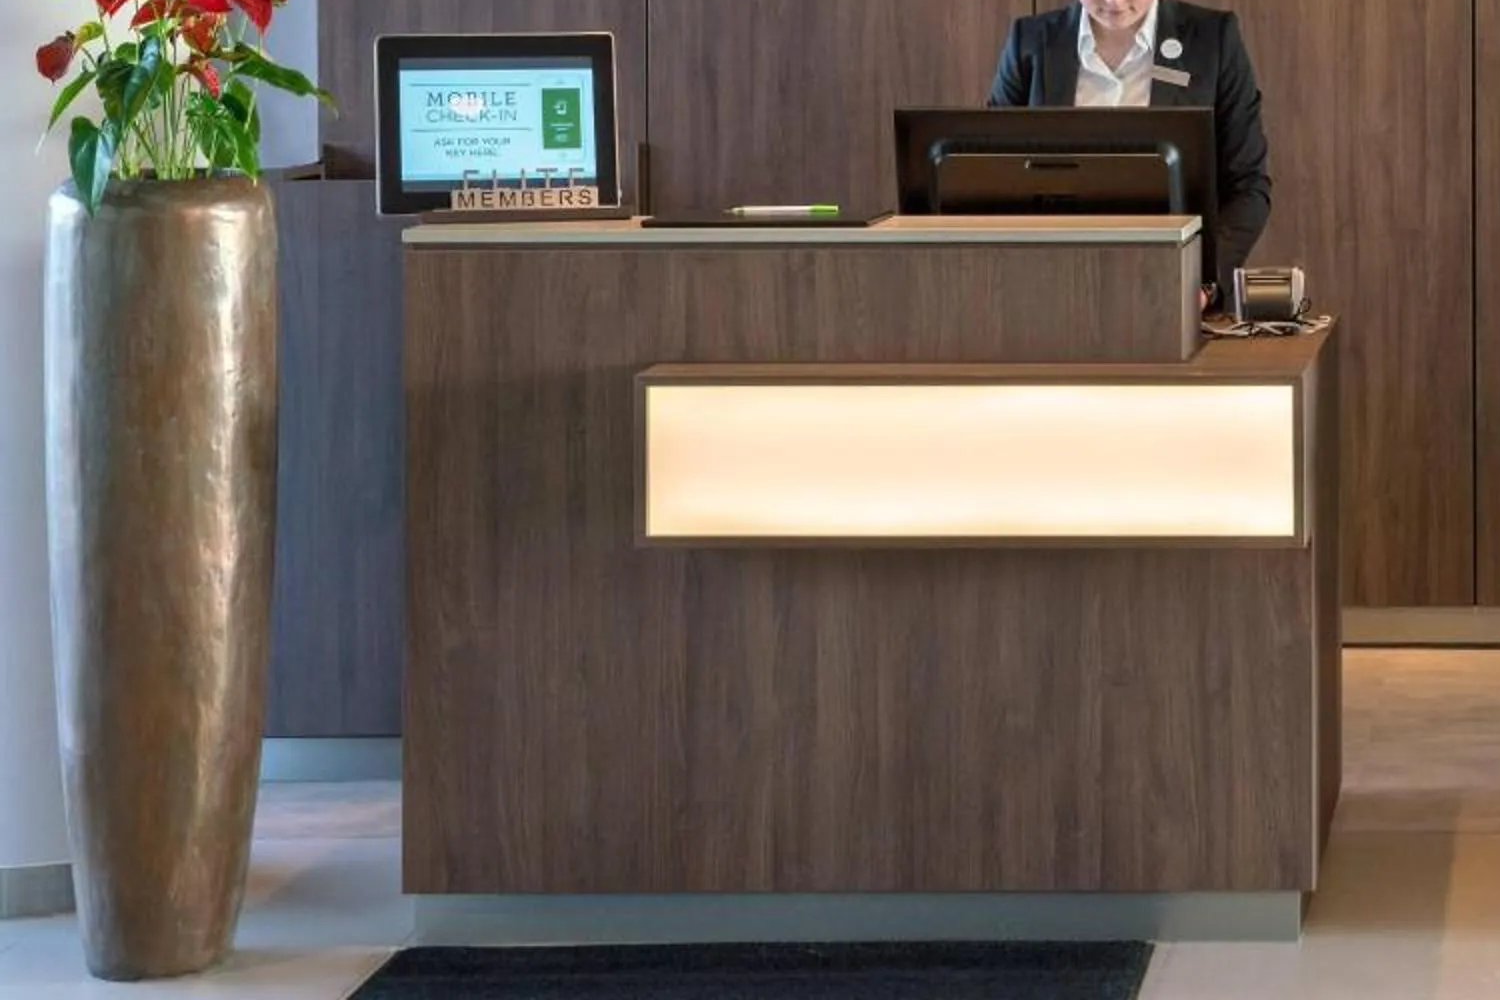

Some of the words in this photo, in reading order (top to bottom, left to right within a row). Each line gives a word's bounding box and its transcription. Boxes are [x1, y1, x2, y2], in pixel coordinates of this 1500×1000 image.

[426, 90, 517, 107] MOBILE
[425, 108, 518, 123] CHECK-IN
[457, 189, 592, 209] MEMBERS
